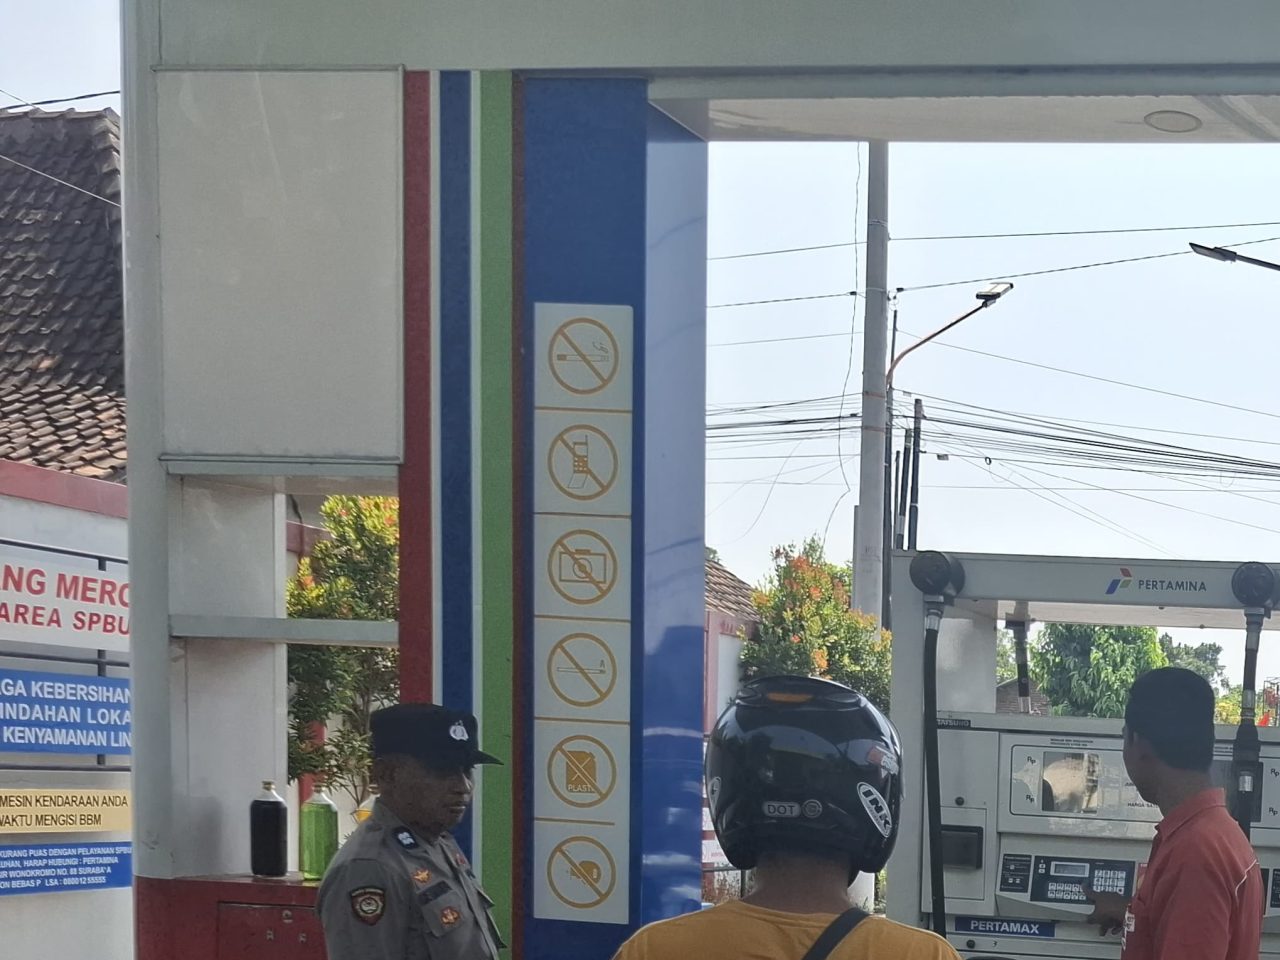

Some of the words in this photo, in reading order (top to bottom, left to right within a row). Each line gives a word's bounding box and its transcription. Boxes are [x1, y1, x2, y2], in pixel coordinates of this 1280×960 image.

[0, 564, 46, 595] NG
[1138, 579, 1207, 592] PERTAMINA
[0, 679, 27, 697] GA
[3, 726, 107, 746] KENYAMANAN
[35, 795, 99, 807] KENDARAAN
[101, 795, 128, 807] ANDA
[767, 804, 796, 815] DOT
[35, 814, 77, 826] MENGISI
[79, 813, 102, 826] BBM
[78, 866, 112, 875] SURABAA
[970, 920, 1040, 935] PERTAMAX
